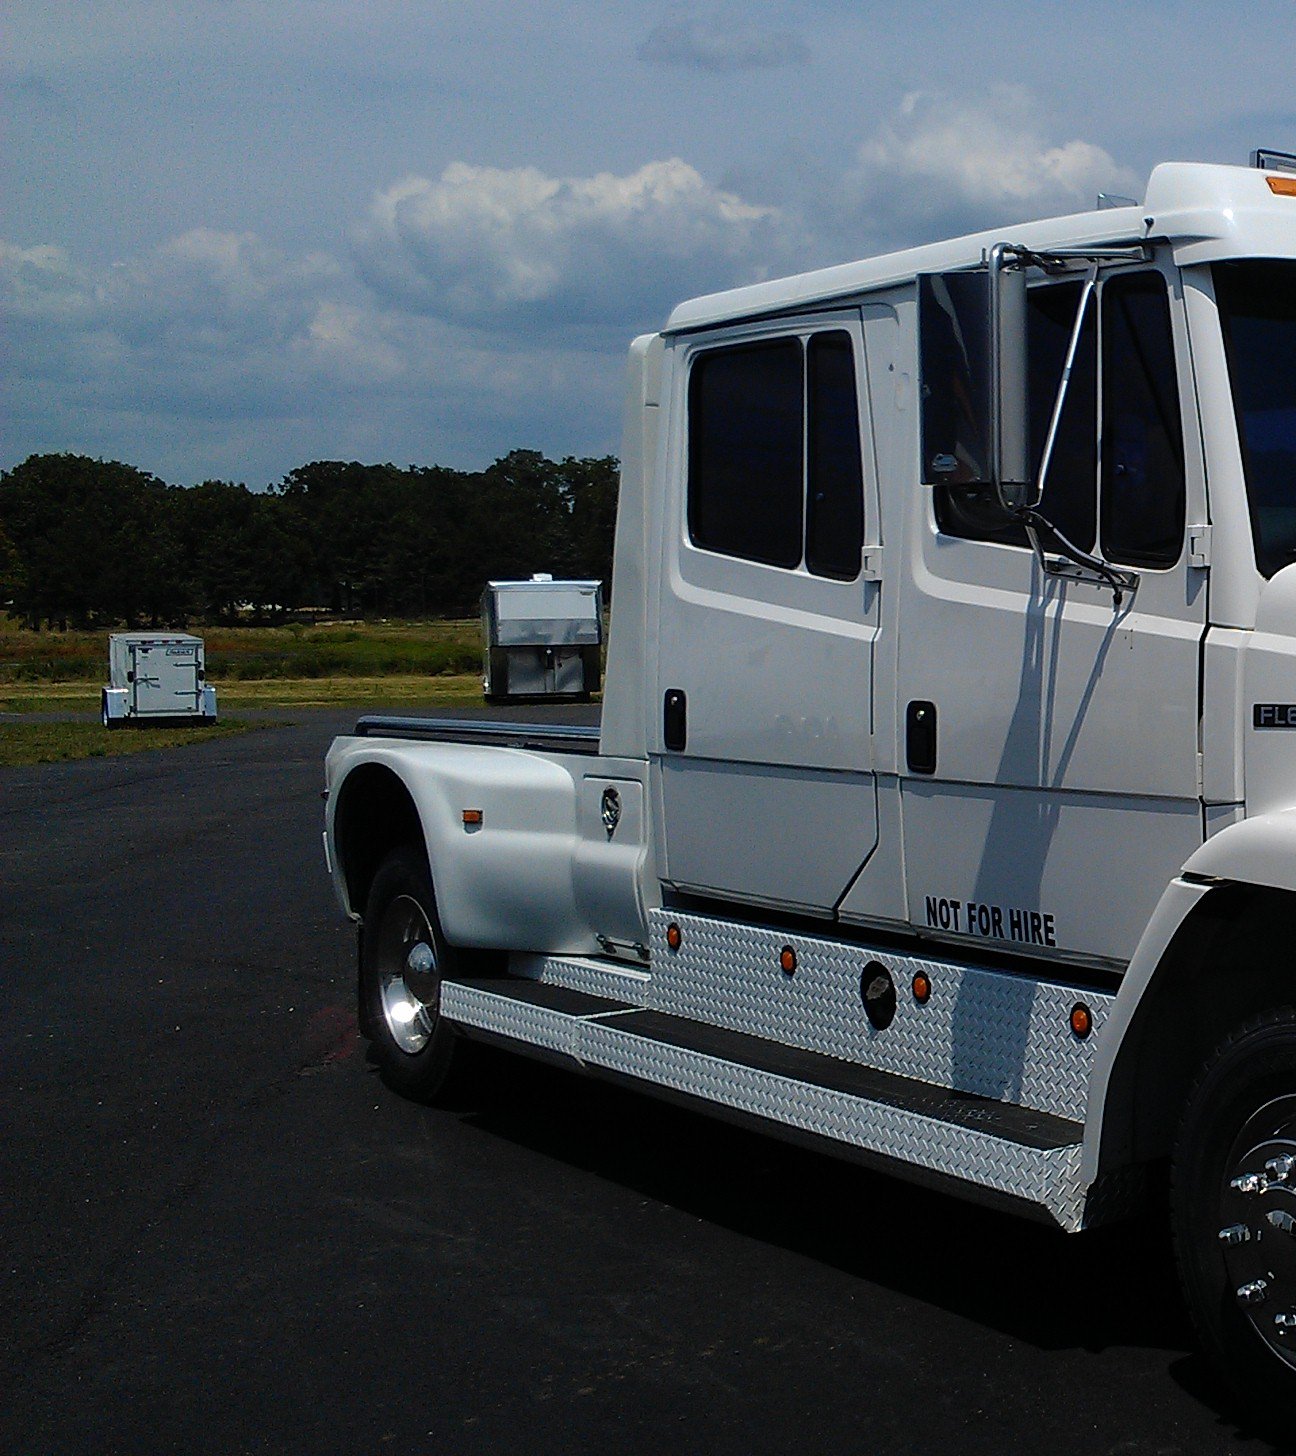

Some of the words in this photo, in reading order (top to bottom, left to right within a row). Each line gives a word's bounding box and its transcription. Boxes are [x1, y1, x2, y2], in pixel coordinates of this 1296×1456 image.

[925, 895, 961, 931] NOT
[966, 902, 1005, 939] FOR
[1009, 908, 1056, 947] HIRE
